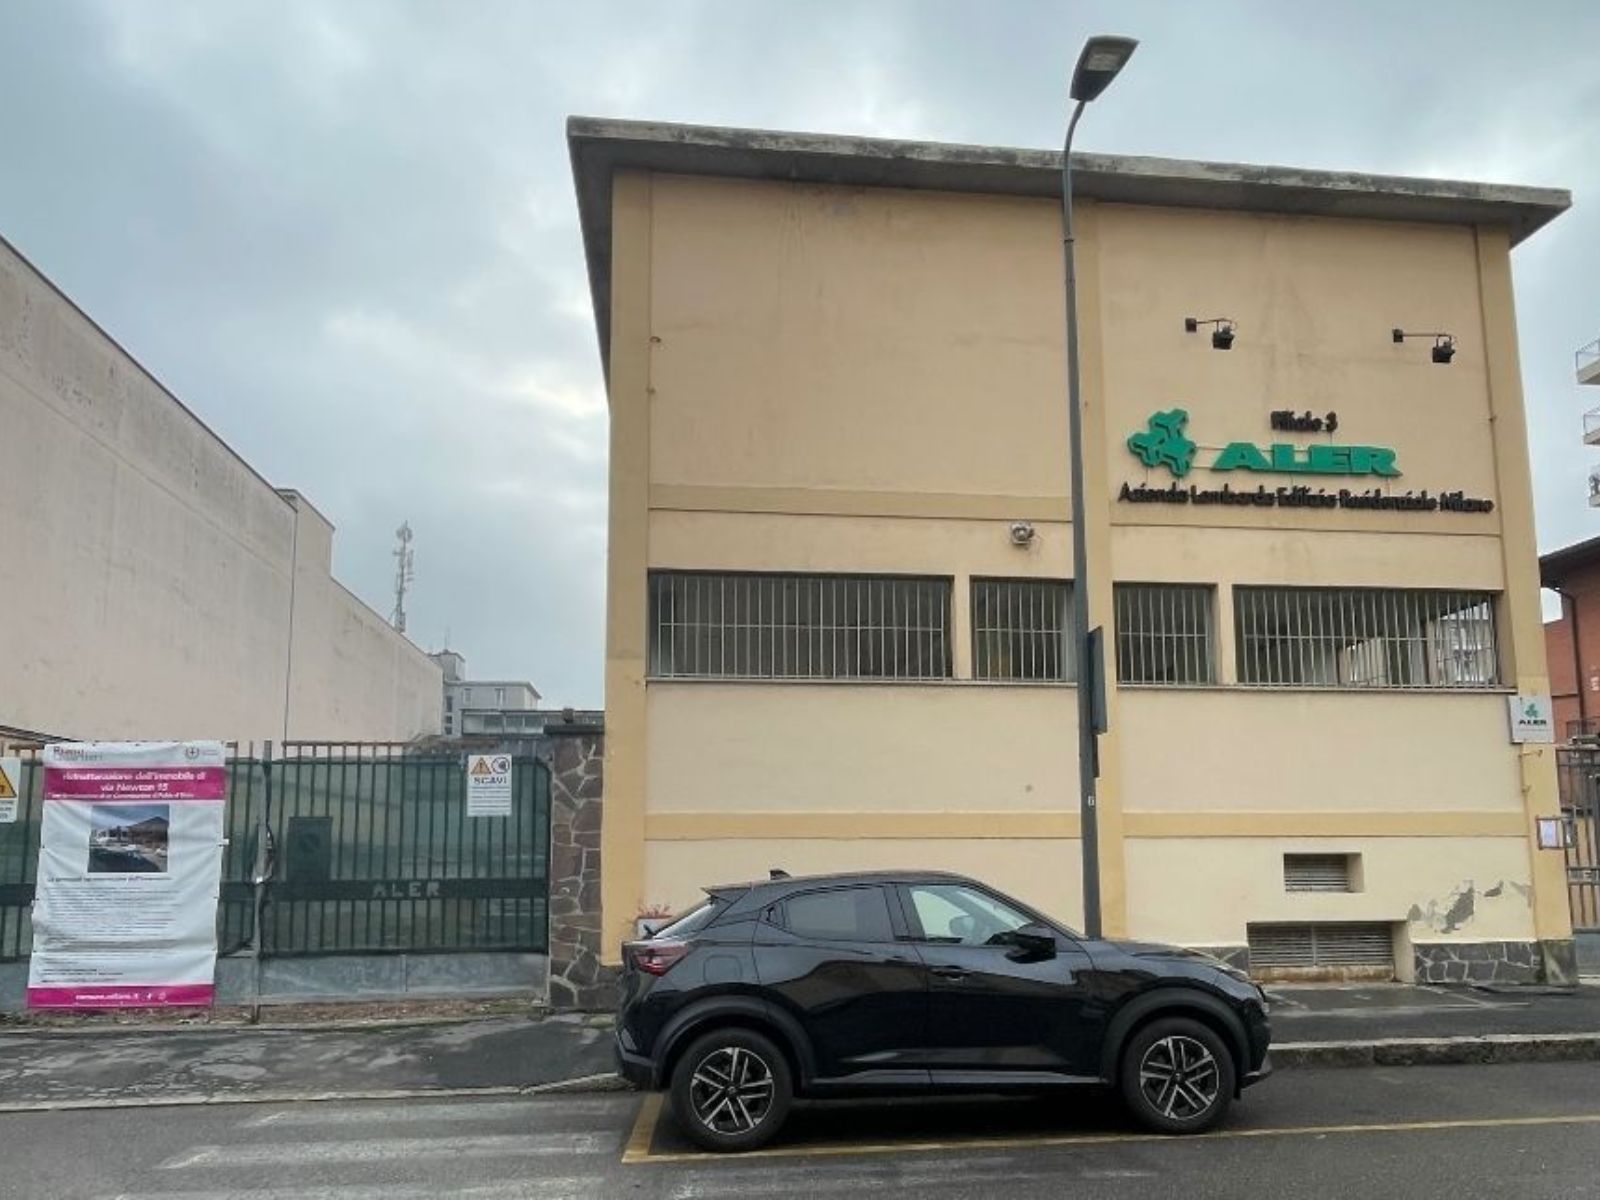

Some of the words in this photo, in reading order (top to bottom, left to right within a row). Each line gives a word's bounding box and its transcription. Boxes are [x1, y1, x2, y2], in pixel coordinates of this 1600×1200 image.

[1325, 411, 1338, 432] 3
[1210, 441, 1403, 477] ALER
[101, 783, 114, 792] via
[116, 782, 155, 792] Newton
[373, 882, 440, 897] ALER
